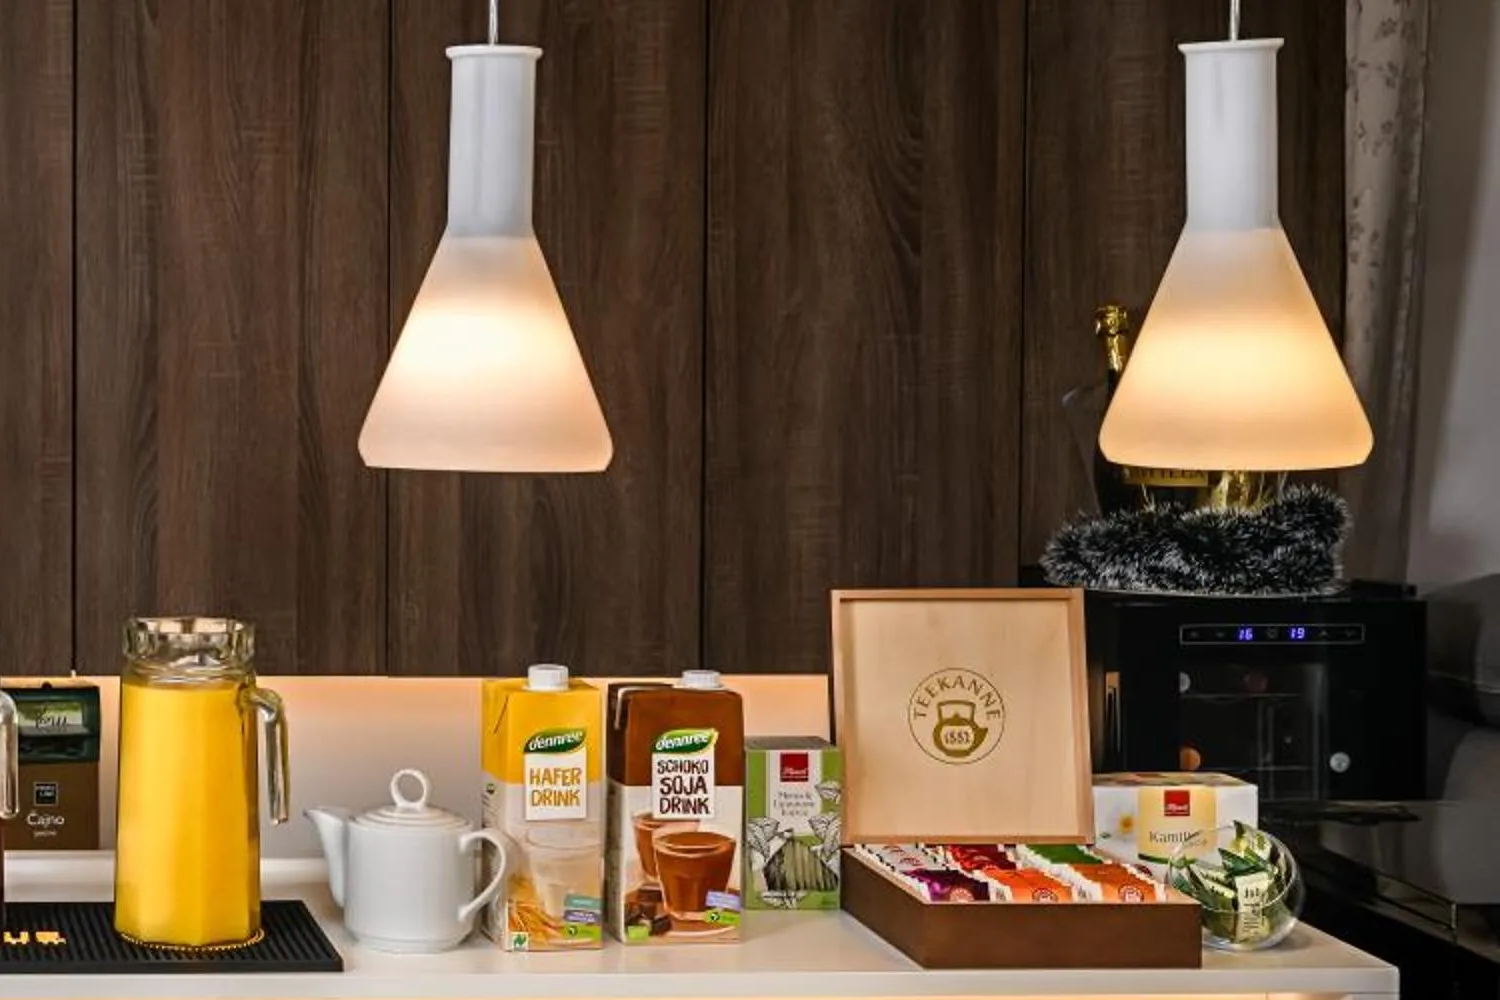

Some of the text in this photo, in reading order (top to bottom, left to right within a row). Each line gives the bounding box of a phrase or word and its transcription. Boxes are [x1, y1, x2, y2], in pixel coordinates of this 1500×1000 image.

[1239, 628, 1305, 640] 16 19
[913, 675, 1001, 720] TEEKANNE
[529, 767, 582, 786] HAFER
[657, 759, 709, 775] SCHOKO
[660, 775, 708, 796] SOJA
[531, 788, 581, 807] DRINK
[660, 796, 710, 815] DRINK
